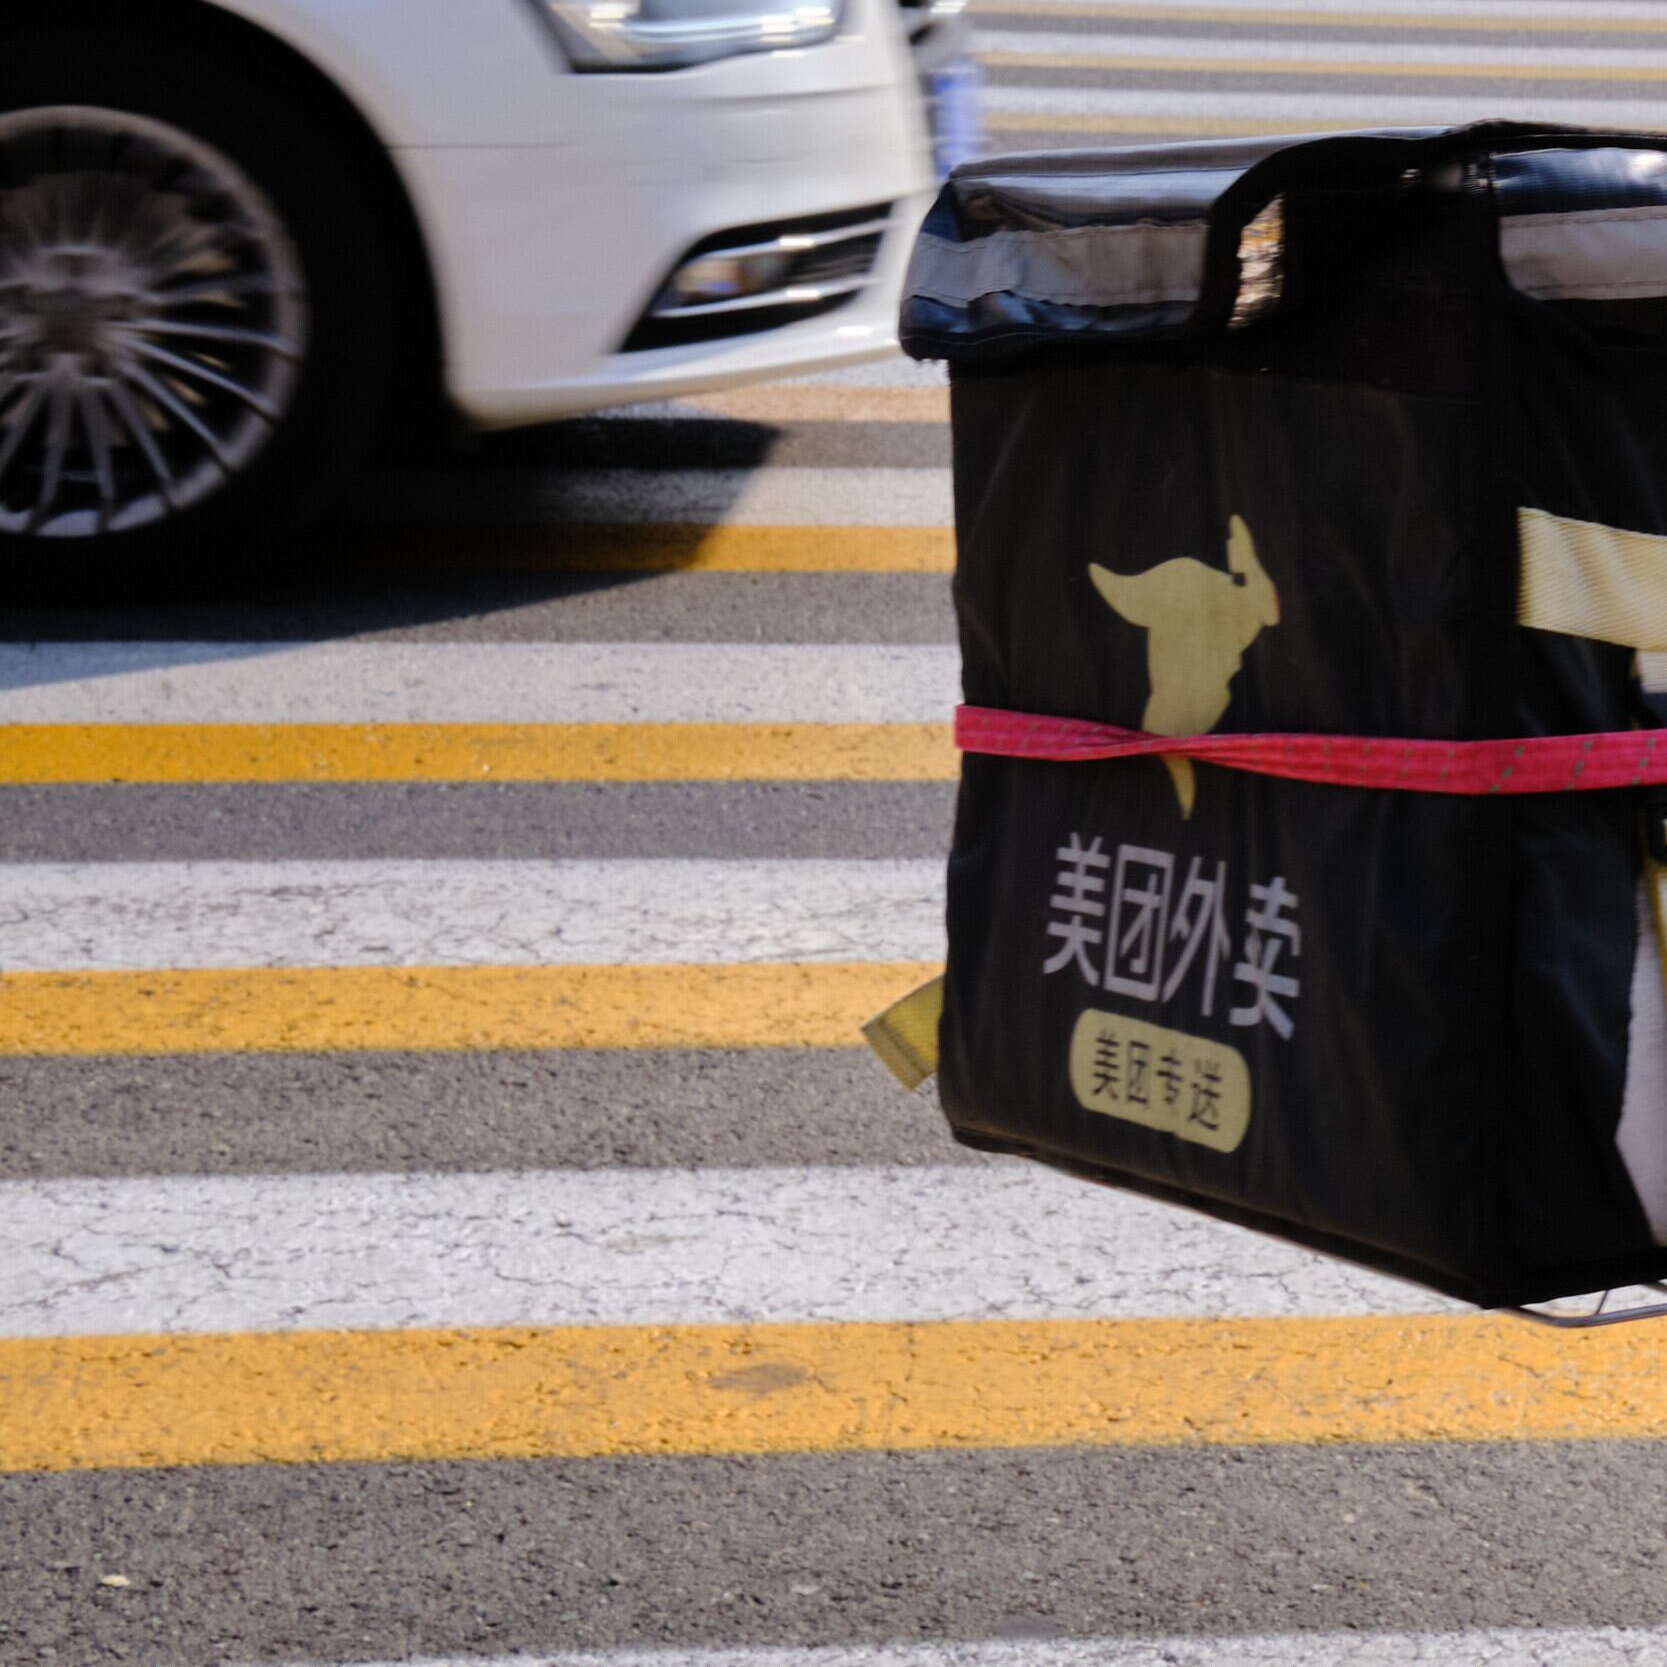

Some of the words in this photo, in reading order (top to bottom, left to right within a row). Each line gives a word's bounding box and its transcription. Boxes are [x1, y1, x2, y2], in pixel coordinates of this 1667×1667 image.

[1043, 832, 1301, 1041] 美团外卖
[1093, 1030, 1223, 1131] 美团专送
